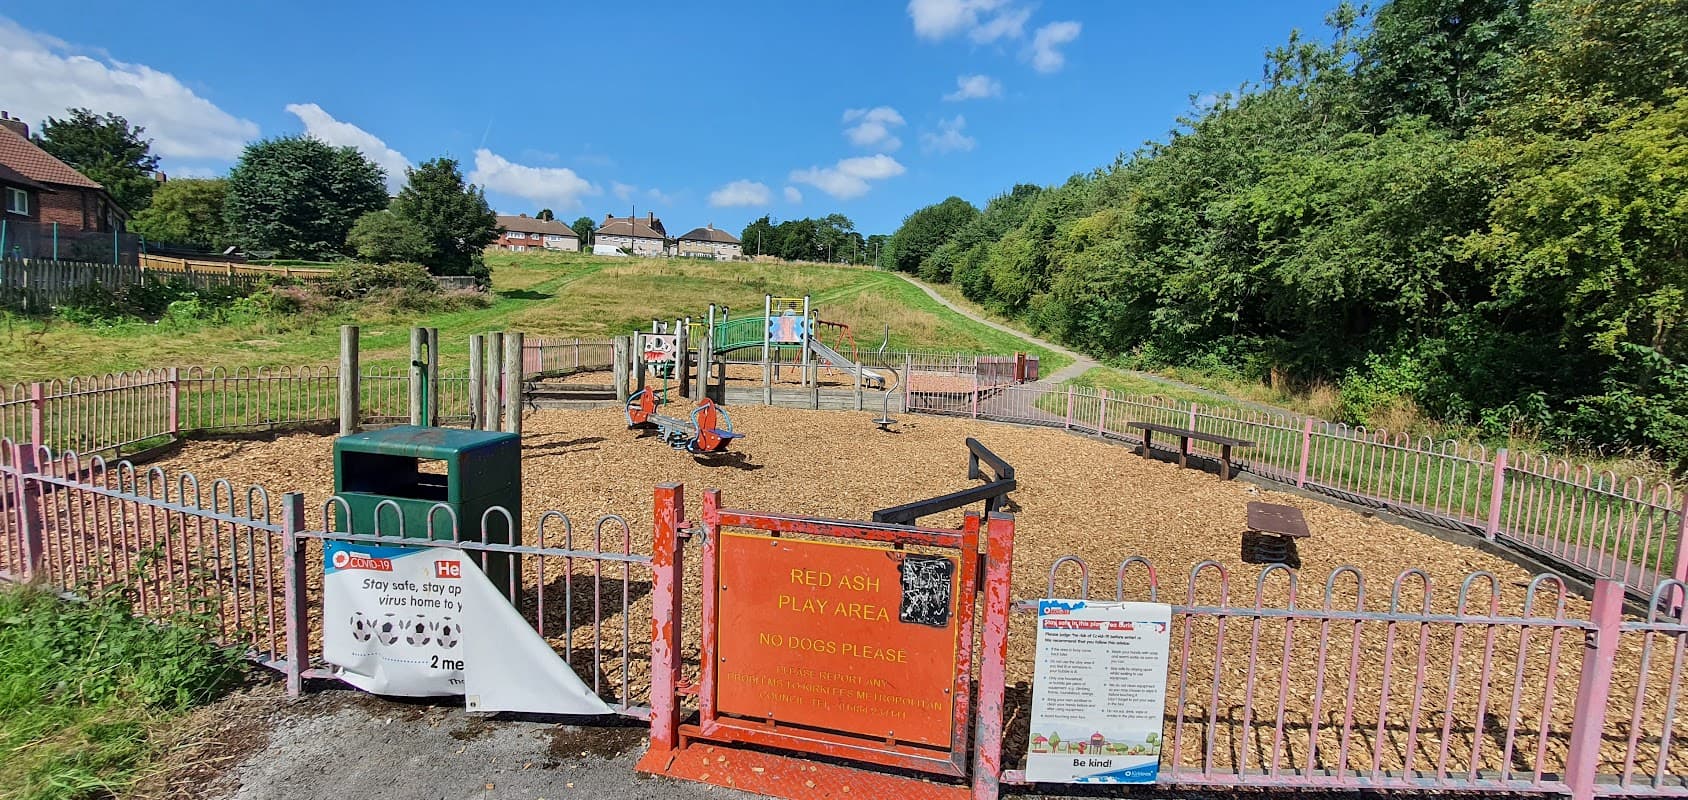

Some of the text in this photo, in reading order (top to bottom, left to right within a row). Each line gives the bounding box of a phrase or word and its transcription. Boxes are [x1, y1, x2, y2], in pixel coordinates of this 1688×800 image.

[350, 557, 390, 569] COVID-19
[362, 578, 390, 592] Stay
[392, 581, 419, 593] safe,
[422, 583, 445, 596] stay
[791, 568, 880, 593] RED ASH
[379, 595, 407, 606] virus
[410, 596, 441, 608] home
[444, 599, 454, 609] to
[778, 594, 890, 623] PLAY AREA
[760, 632, 907, 663] NO DOGS PLEASE
[430, 654, 465, 671] 2 me
[776, 665, 888, 689] PLEASE REPORT ANY
[727, 671, 783, 687] PROBLEMS
[802, 683, 854, 698] KIRKLEES
[856, 690, 943, 711] METROPOLITAN
[1073, 758, 1112, 768] Be kind!
